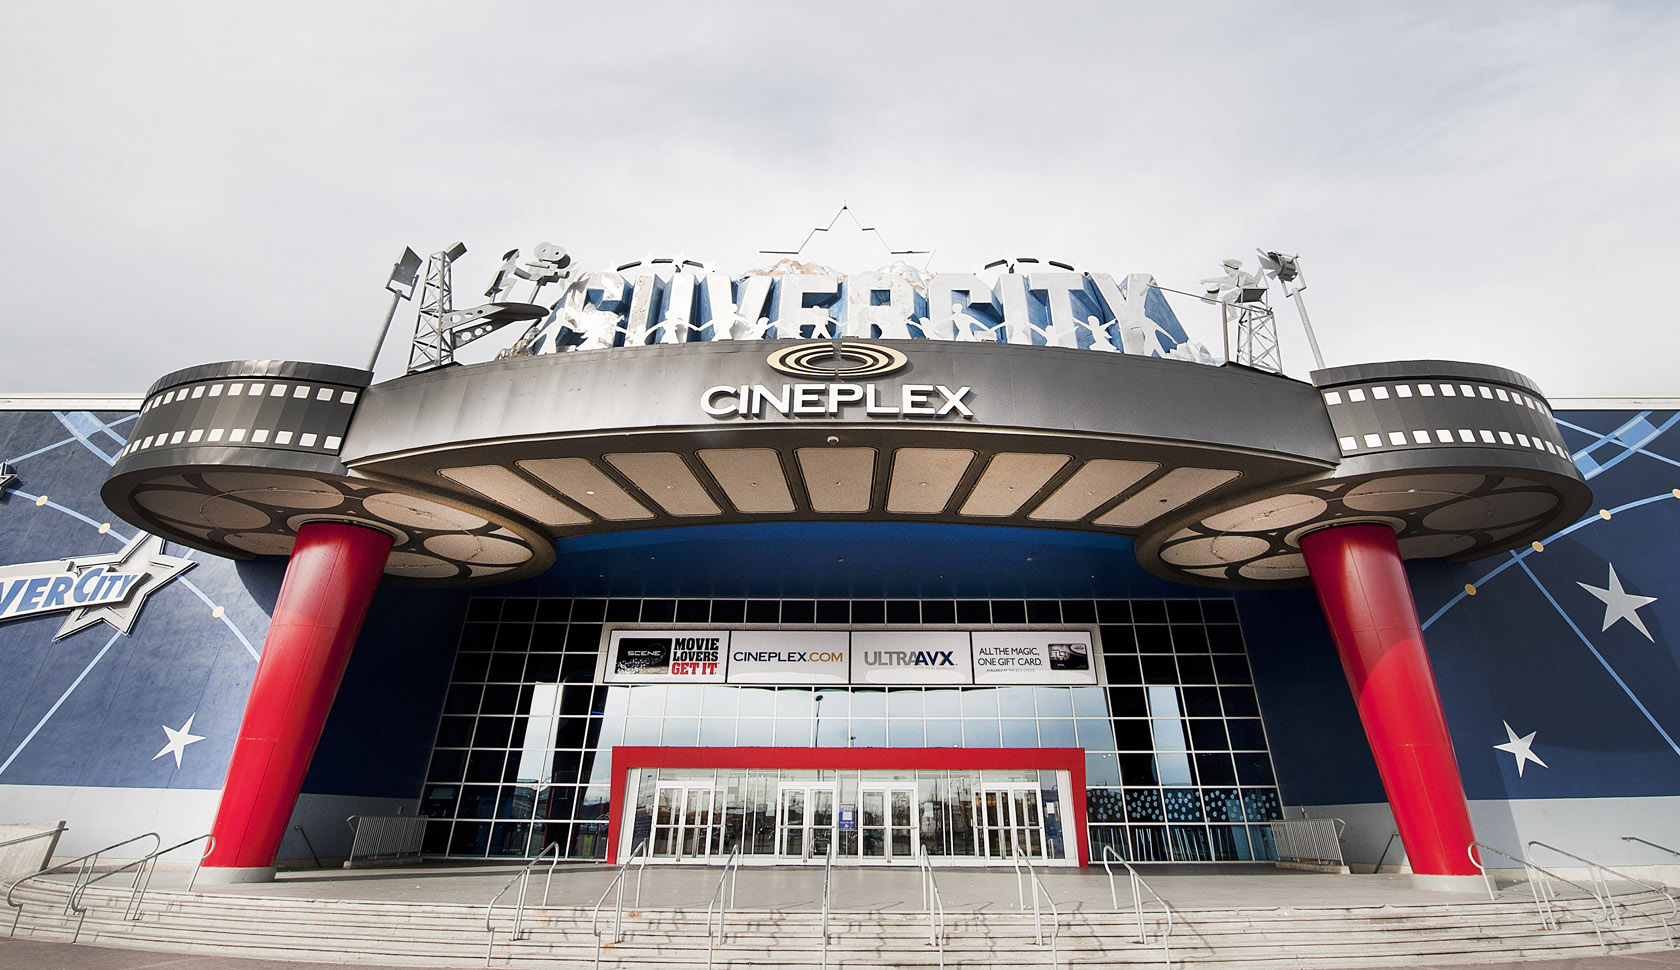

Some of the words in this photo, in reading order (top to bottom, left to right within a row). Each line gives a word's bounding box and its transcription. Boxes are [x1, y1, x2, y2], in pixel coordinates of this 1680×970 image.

[700, 383, 974, 419] CINEPLEX
[674, 638, 720, 651] MOVIE
[672, 651, 719, 662] LOVERS
[733, 652, 844, 663] CINEPLEX.COM
[979, 647, 994, 656] ALL
[993, 647, 1010, 656] THE
[1011, 647, 1040, 657] MAGIC,
[977, 657, 997, 666] ONE
[997, 657, 1016, 666] GIFT
[1017, 657, 1043, 666] CARD.
[671, 662, 700, 675] GET
